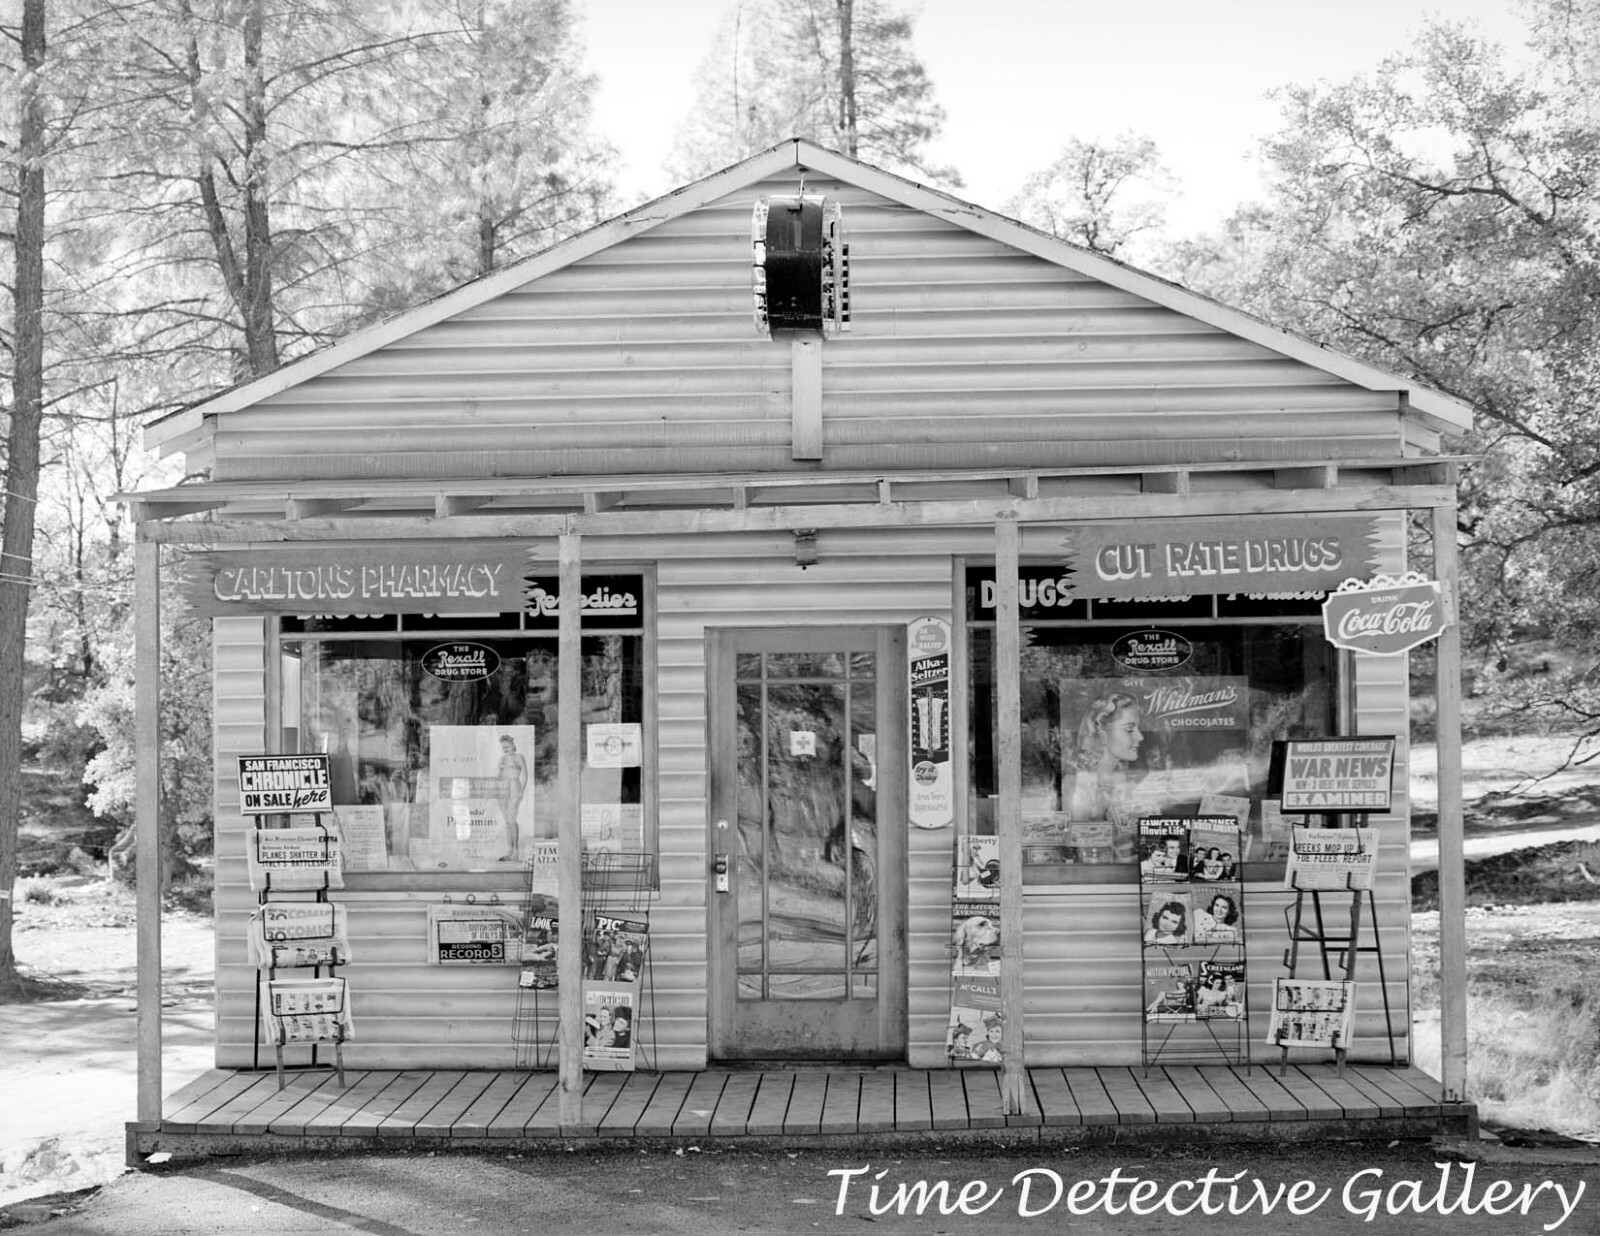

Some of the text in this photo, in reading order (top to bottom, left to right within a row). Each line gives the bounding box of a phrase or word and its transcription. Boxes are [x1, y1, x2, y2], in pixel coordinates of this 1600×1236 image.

[1095, 535, 1342, 581] CUT RATE DRUGS
[362, 562, 502, 599] PHARMACY
[981, 578, 1074, 608] DUGS
[1371, 594, 1399, 604] DRINK
[529, 586, 637, 616] Reedies
[1338, 600, 1434, 639] Coca-Cola
[1143, 633, 1160, 641] THE
[453, 645, 469, 653] THE
[1128, 638, 1177, 657] Rexall
[437, 650, 486, 668] Rexall
[914, 658, 945, 671] Alka-
[1125, 656, 1179, 665] DRUG STORE
[434, 668, 459, 676] DRUG
[911, 667, 949, 681] Seltzer
[1124, 679, 1144, 687] GIVE
[1143, 685, 1239, 717] Whitman's
[1170, 717, 1235, 728] CHOCOLATES
[245, 758, 321, 771] SAN FRANCISCO
[1290, 757, 1389, 779] WAR NEWS
[241, 770, 328, 791] CHRONICLE
[245, 787, 328, 810] ON SALE here
[1287, 792, 1387, 806] EXAMINER
[1140, 826, 1167, 836] Movie
[1168, 826, 1185, 836] Life
[967, 836, 998, 846] Liberty
[262, 851, 287, 859] PLANES
[289, 850, 318, 859] SHATTER
[537, 847, 558, 855] TIM
[1324, 843, 1341, 853] MOP
[1344, 844, 1354, 854] UP
[537, 856, 559, 864] ATLA
[1343, 854, 1373, 863] REPORT
[531, 916, 552, 931] LOOK
[596, 916, 625, 931] PIC
[266, 924, 340, 941] 30 COMICS
[440, 949, 491, 959] RECORD
[1200, 961, 1244, 976] SCREENLAND
